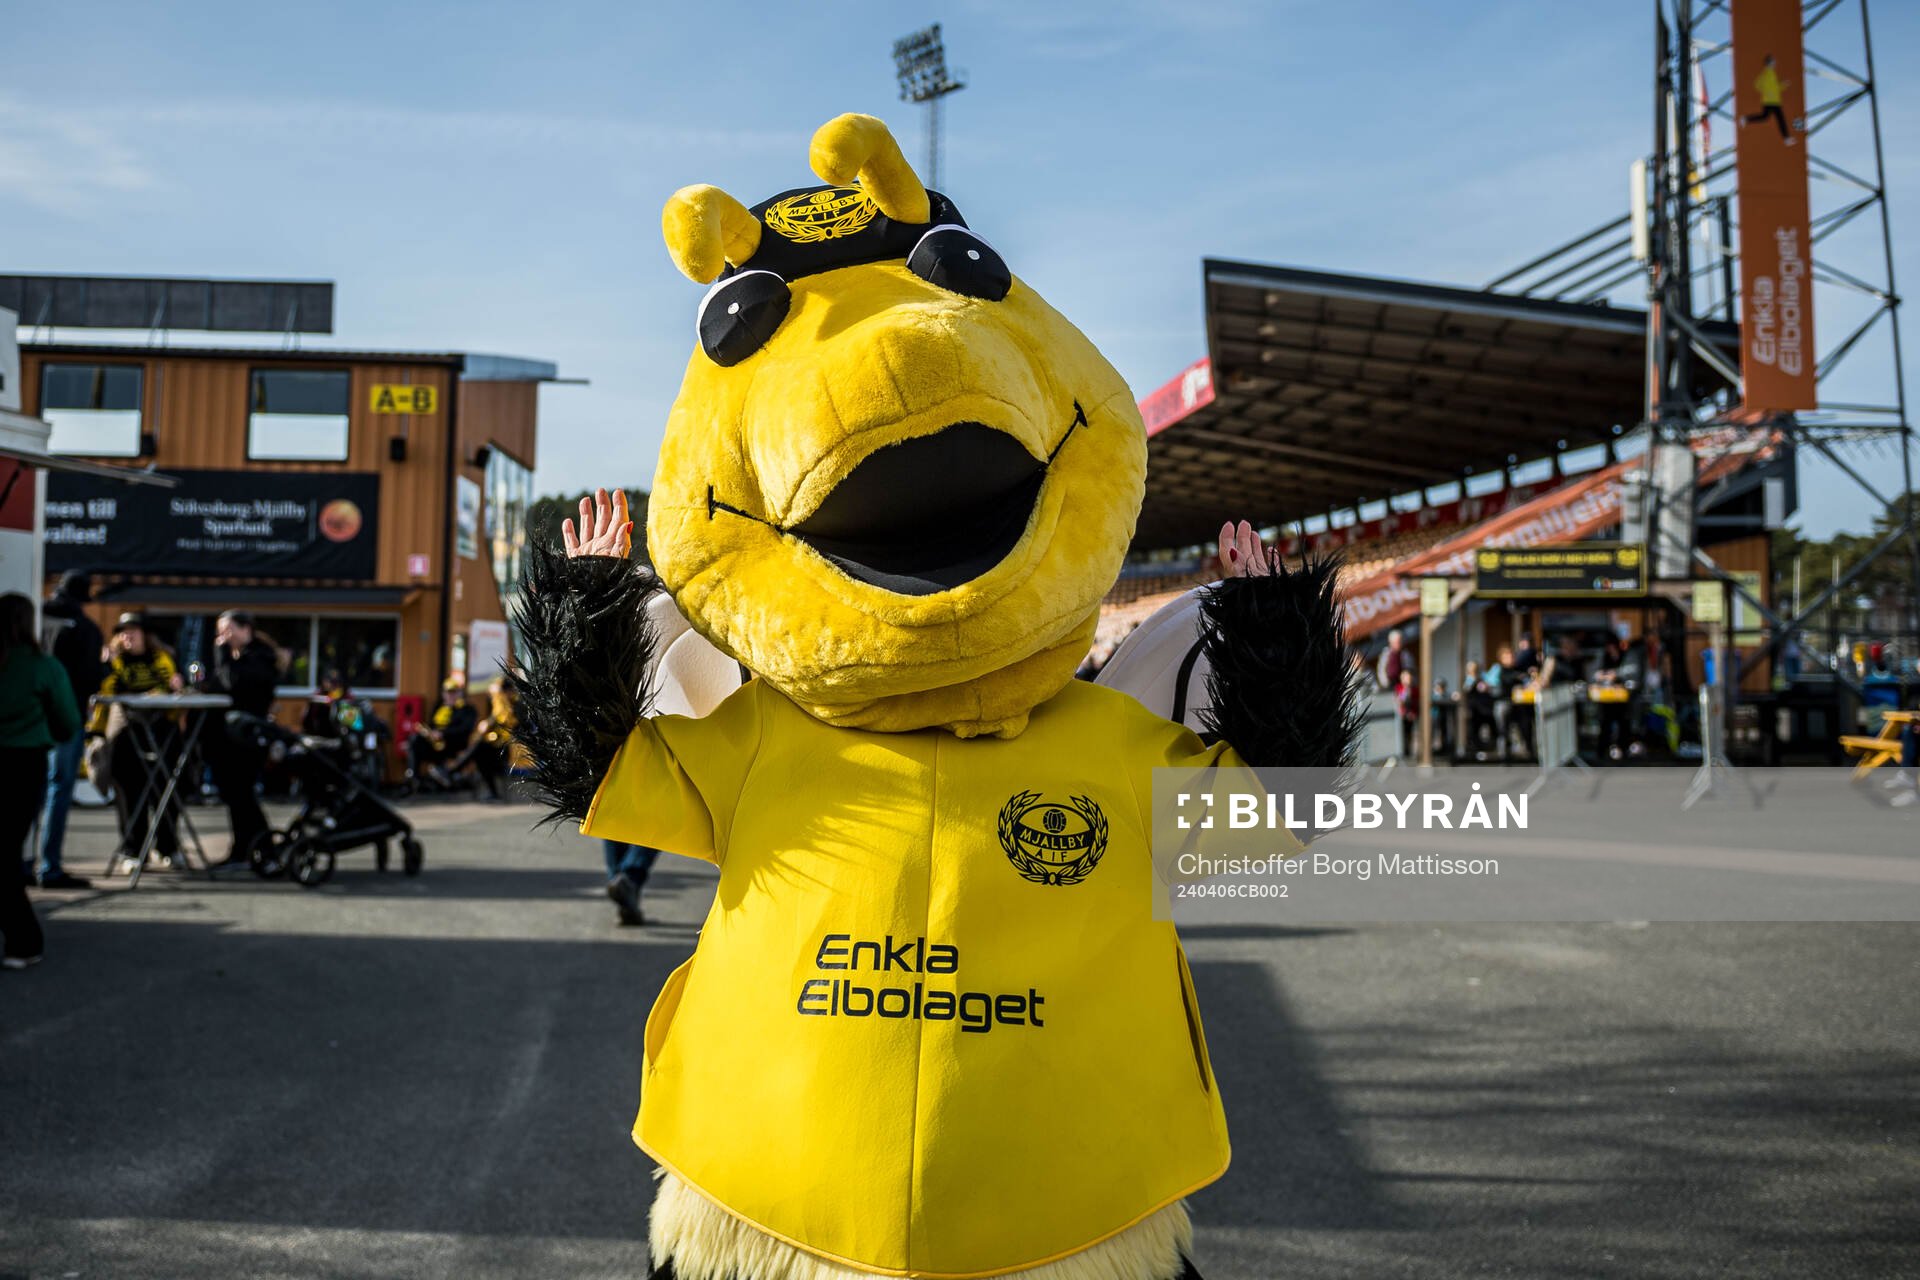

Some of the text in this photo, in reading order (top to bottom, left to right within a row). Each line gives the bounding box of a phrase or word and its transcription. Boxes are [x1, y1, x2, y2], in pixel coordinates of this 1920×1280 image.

[1751, 275, 1776, 365] Enkla
[1774, 226, 1805, 376] Elbolaget
[376, 385, 432, 413] A-B
[1035, 848, 1068, 862] AIF
[816, 934, 959, 975] Enkla
[797, 979, 1045, 1033] Elbolaget
